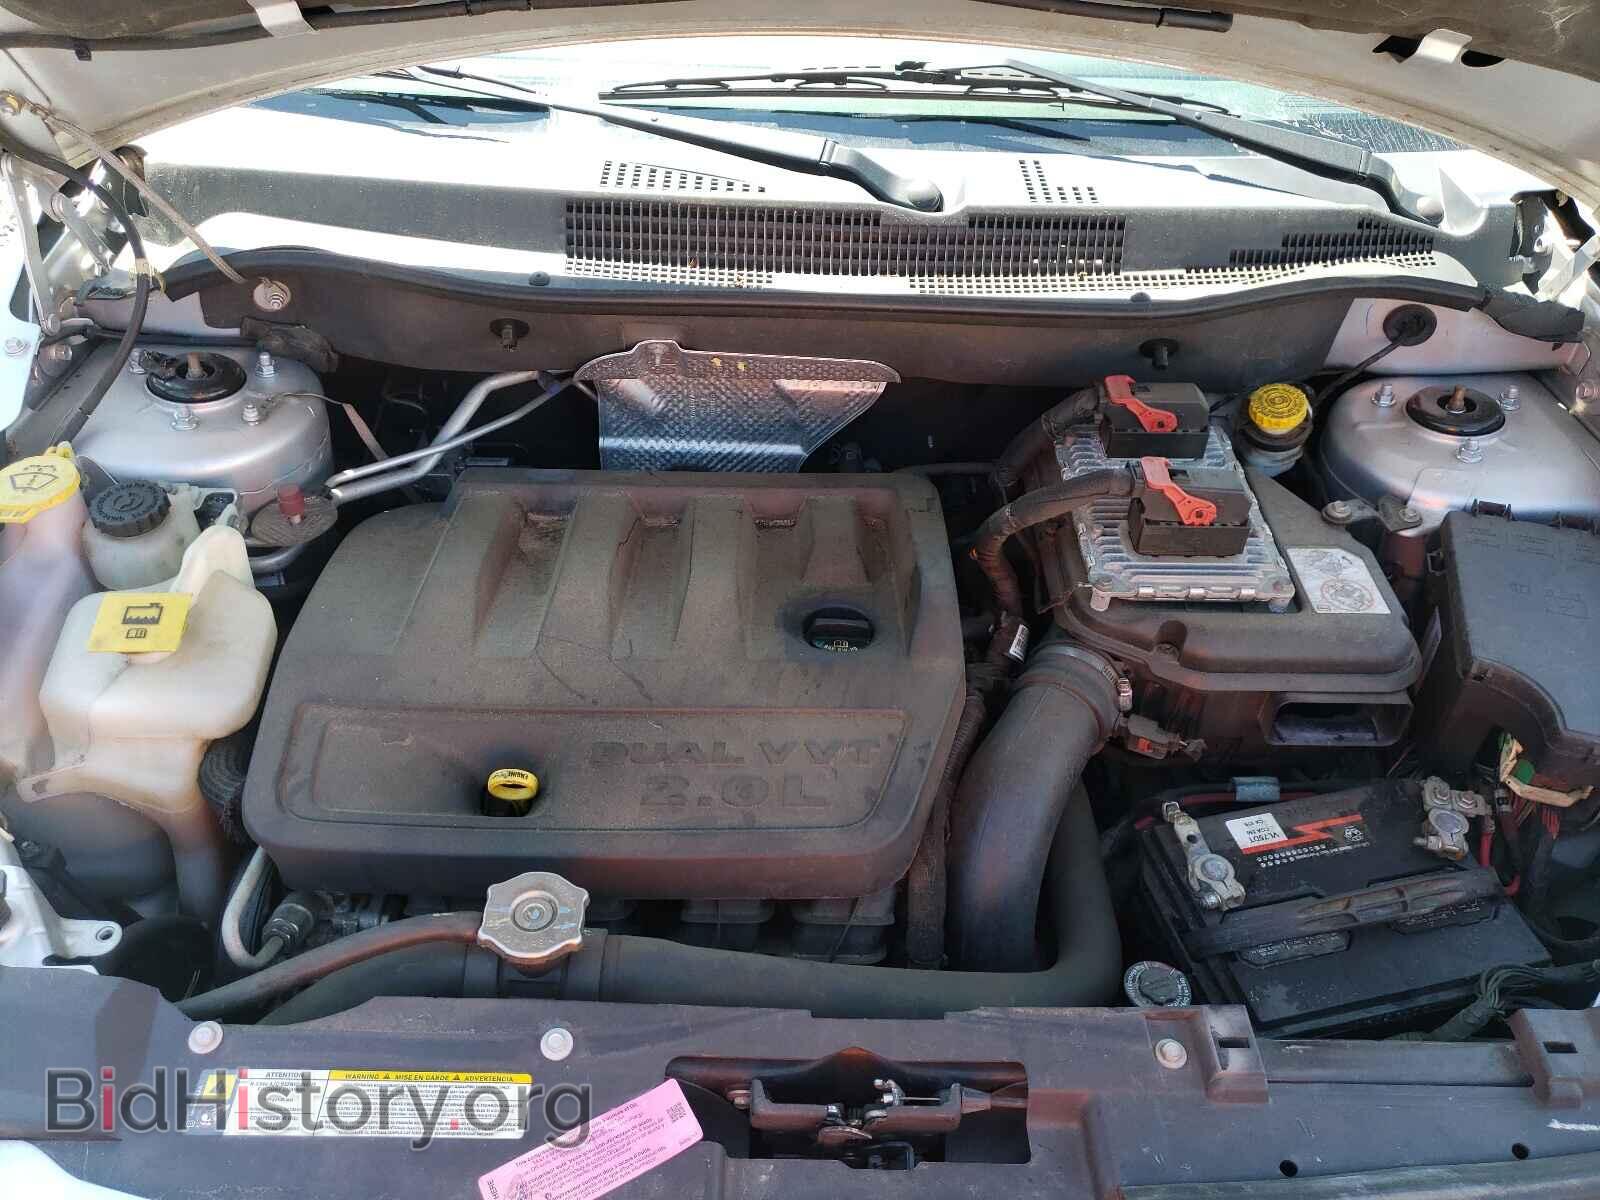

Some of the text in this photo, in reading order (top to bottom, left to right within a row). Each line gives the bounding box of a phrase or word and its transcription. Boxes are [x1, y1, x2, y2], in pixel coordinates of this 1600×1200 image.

[591, 739, 881, 767] DUAL VVT
[640, 775, 829, 808] 2.0L
